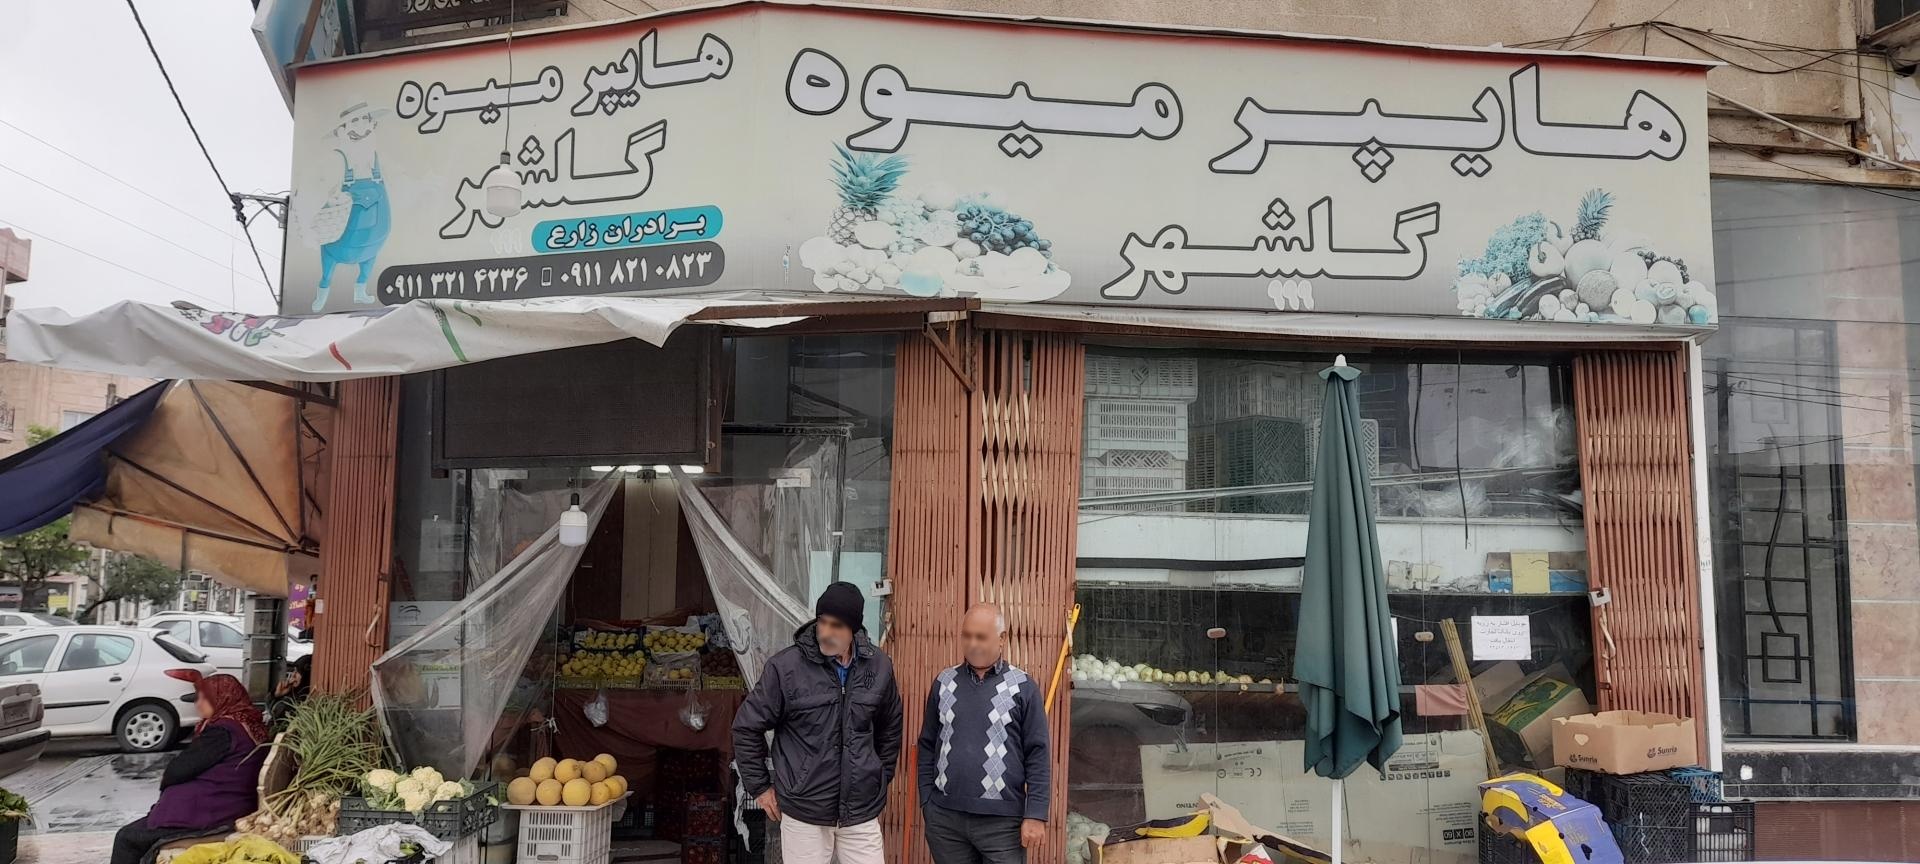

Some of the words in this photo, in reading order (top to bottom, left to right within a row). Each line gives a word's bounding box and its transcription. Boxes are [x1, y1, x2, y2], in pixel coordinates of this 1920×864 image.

[397, 65, 563, 133] میوه
[572, 28, 733, 116] هایپر
[786, 48, 1183, 158] میوه
[1209, 62, 1687, 182] هایپر
[546, 220, 600, 249] زارع
[603, 213, 707, 243] برادران
[1101, 197, 1440, 299] گلشهر
[386, 274, 423, 298] ۰۹۱۱
[430, 270, 465, 296] ۳۲۱
[474, 266, 529, 293] ۴۲۳۶
[560, 261, 601, 287] ۰۹۱۱
[609, 257, 648, 285] ۸۲۱
[655, 250, 713, 281] ۰۸۲۳
